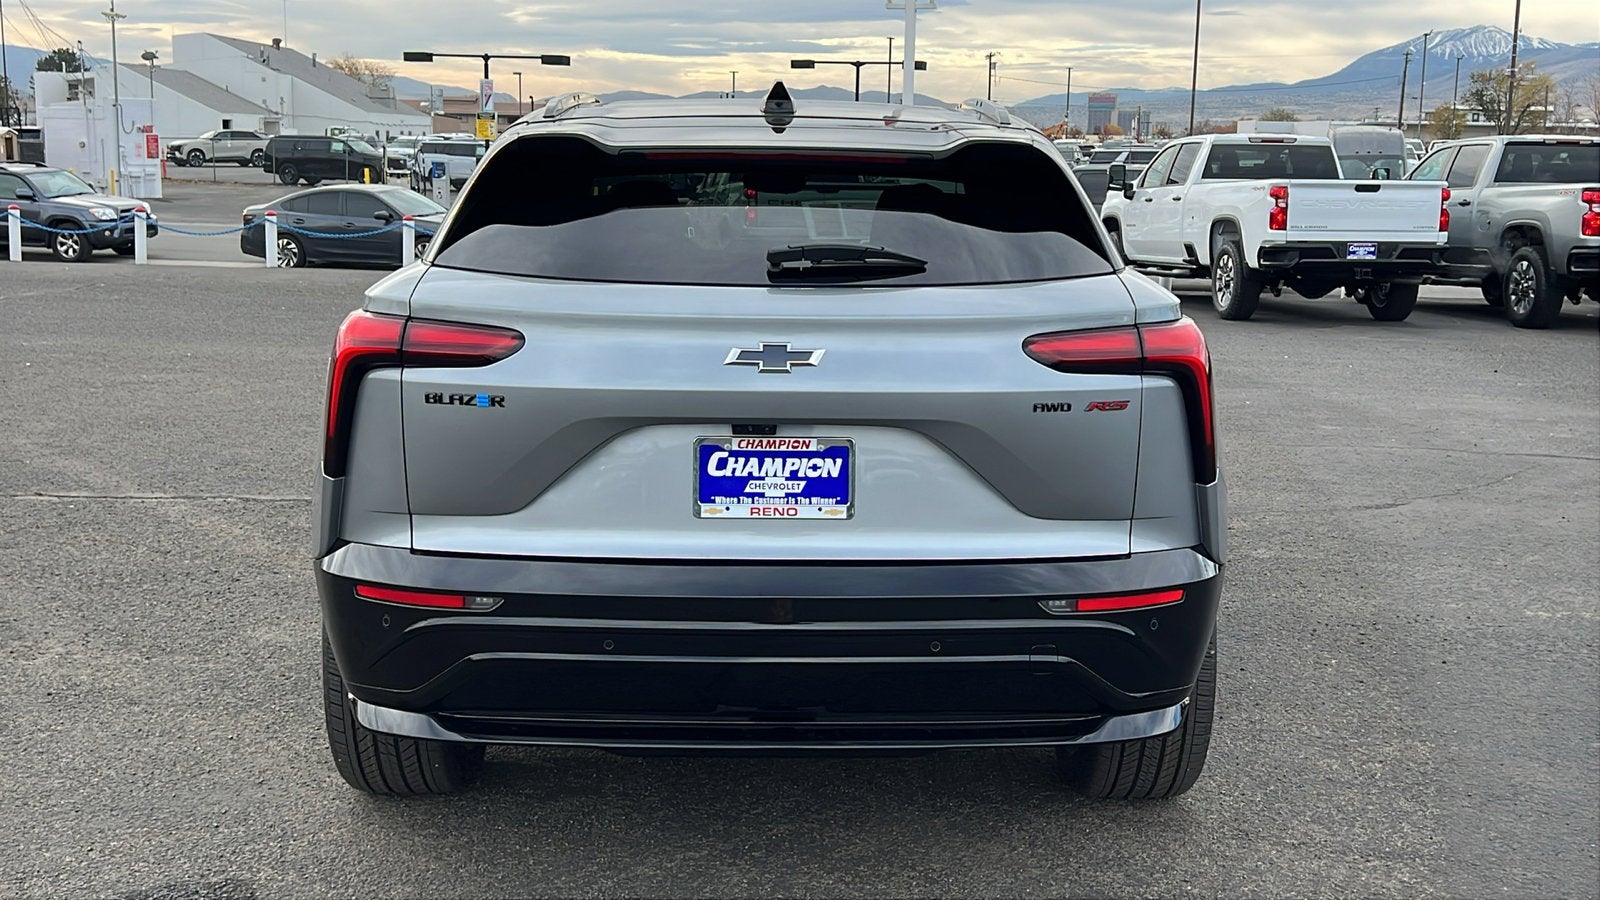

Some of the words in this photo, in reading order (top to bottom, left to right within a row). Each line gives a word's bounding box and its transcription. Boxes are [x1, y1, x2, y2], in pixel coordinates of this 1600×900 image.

[424, 392, 505, 408] BLAZER
[1033, 402, 1072, 413] AWD
[1084, 400, 1130, 412] RS
[737, 439, 811, 449] CHAMPION
[707, 451, 842, 478] CHAMPION
[749, 482, 801, 490] CHEVROLET
[740, 496, 752, 504] The
[755, 496, 787, 504] Customer
[797, 497, 809, 505] The
[750, 507, 798, 517] RENO
